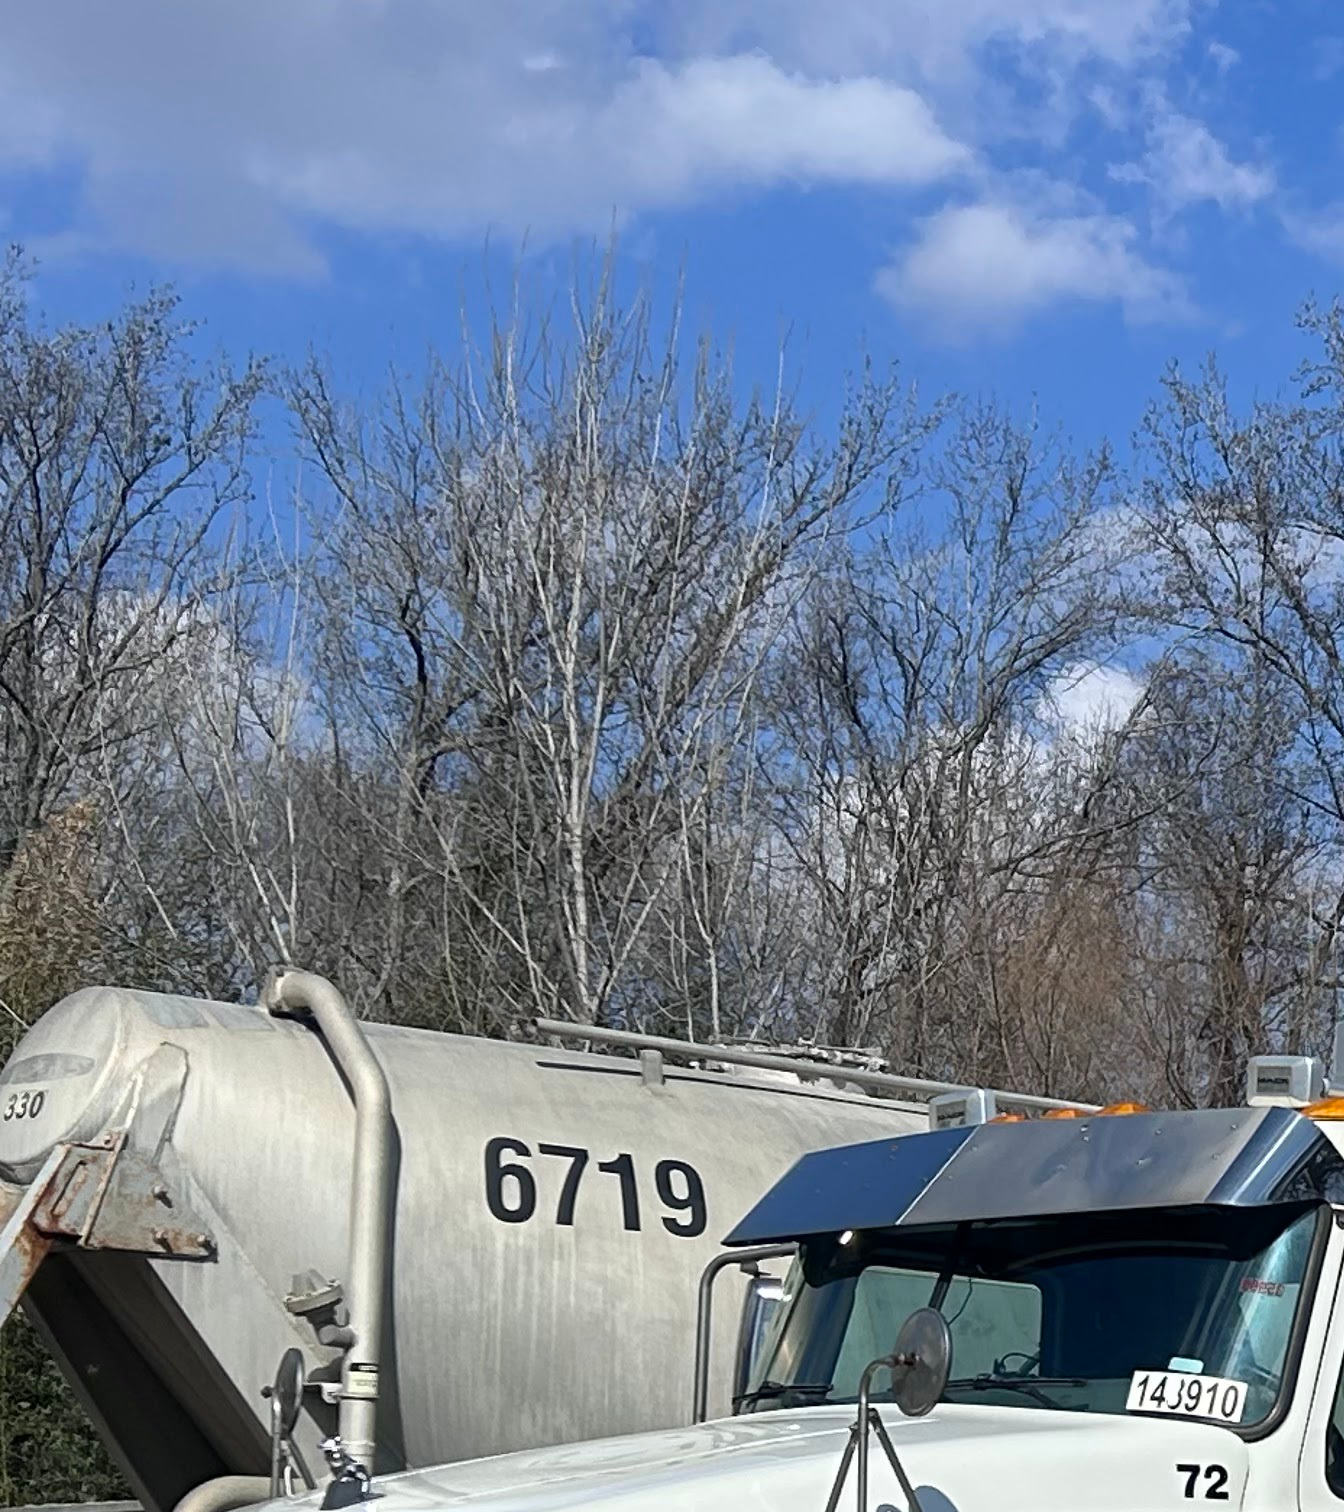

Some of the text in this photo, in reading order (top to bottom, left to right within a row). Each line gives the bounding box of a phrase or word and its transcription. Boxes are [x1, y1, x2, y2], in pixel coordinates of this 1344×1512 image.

[4, 1091, 45, 1121] 330
[485, 1137, 707, 1237] 6719
[1176, 1464, 1229, 1500] 72
